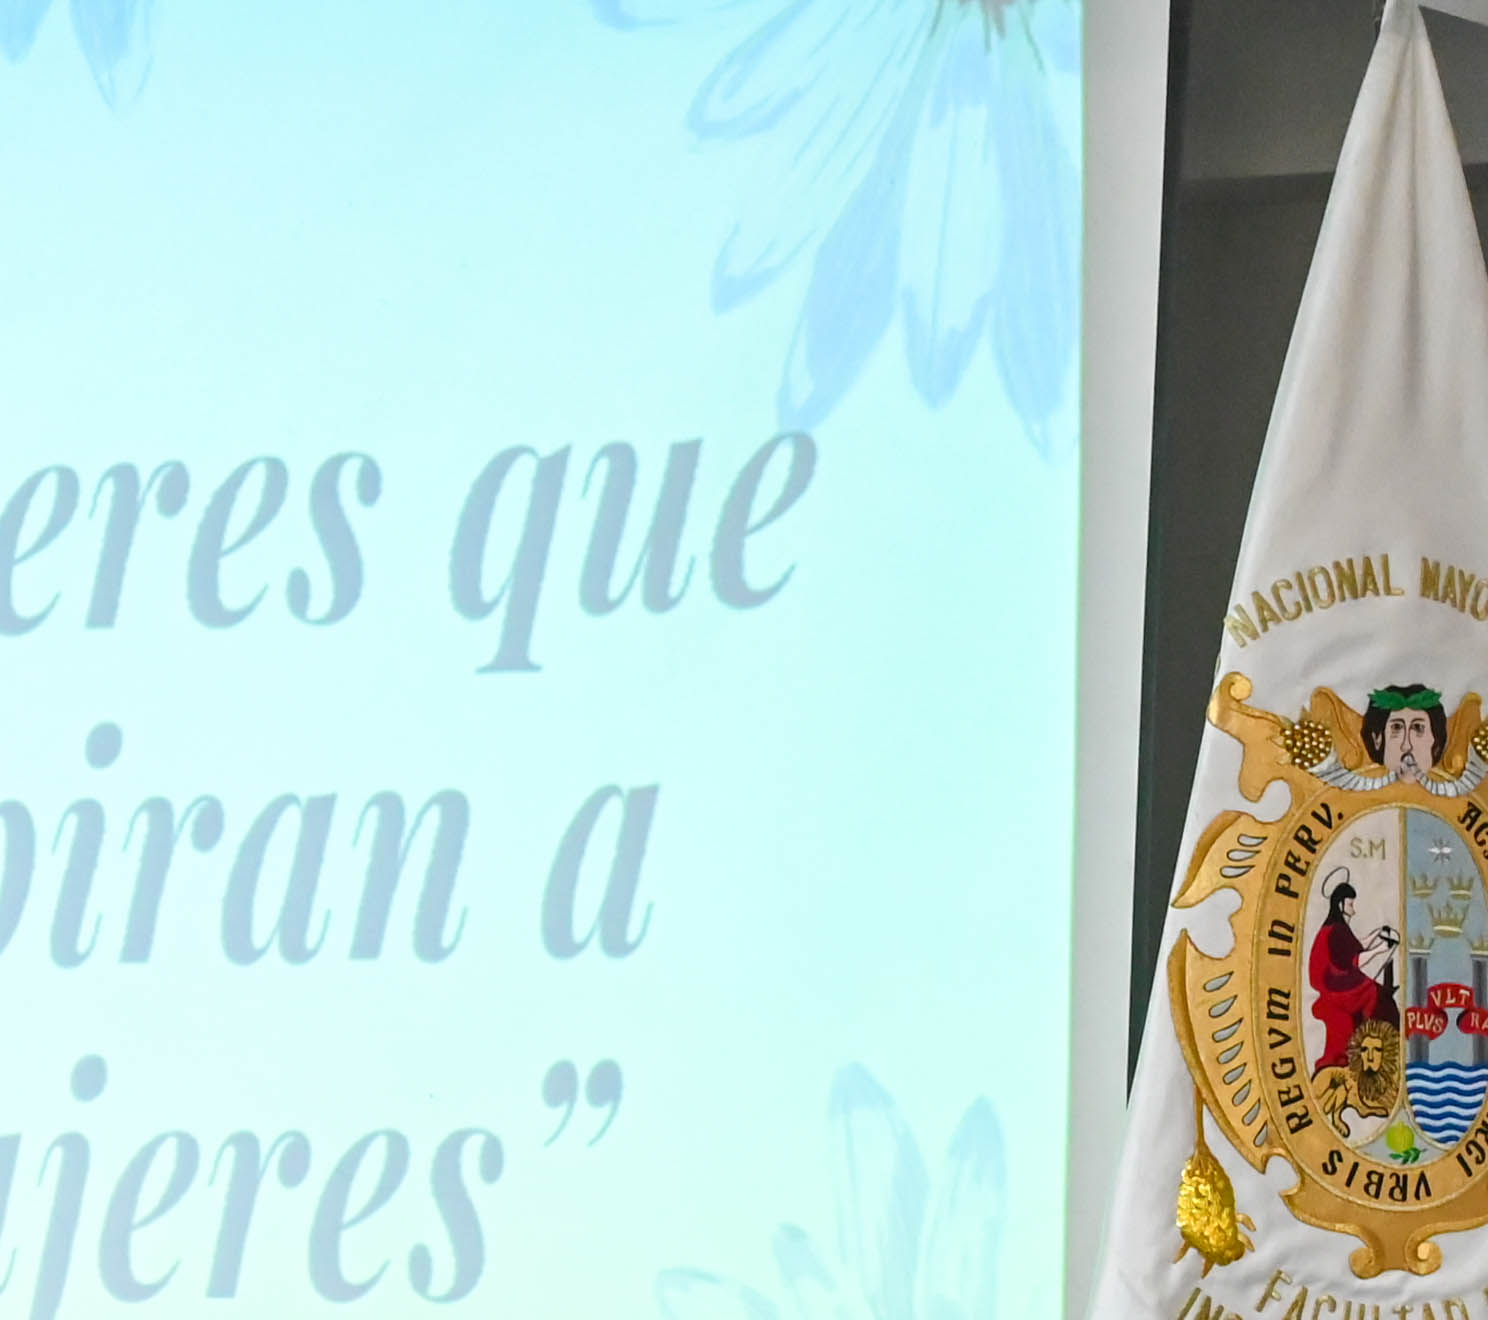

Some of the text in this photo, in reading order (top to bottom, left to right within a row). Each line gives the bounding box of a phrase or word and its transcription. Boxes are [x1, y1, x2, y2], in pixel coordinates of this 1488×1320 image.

[447, 429, 819, 675] que
[1223, 553, 1405, 649] NACIONAL
[540, 781, 662, 962] a
[1407, 1011, 1444, 1033] PLVS
[1430, 988, 1470, 1008] VLT
[1322, 1149, 1432, 1202] VRBIS
